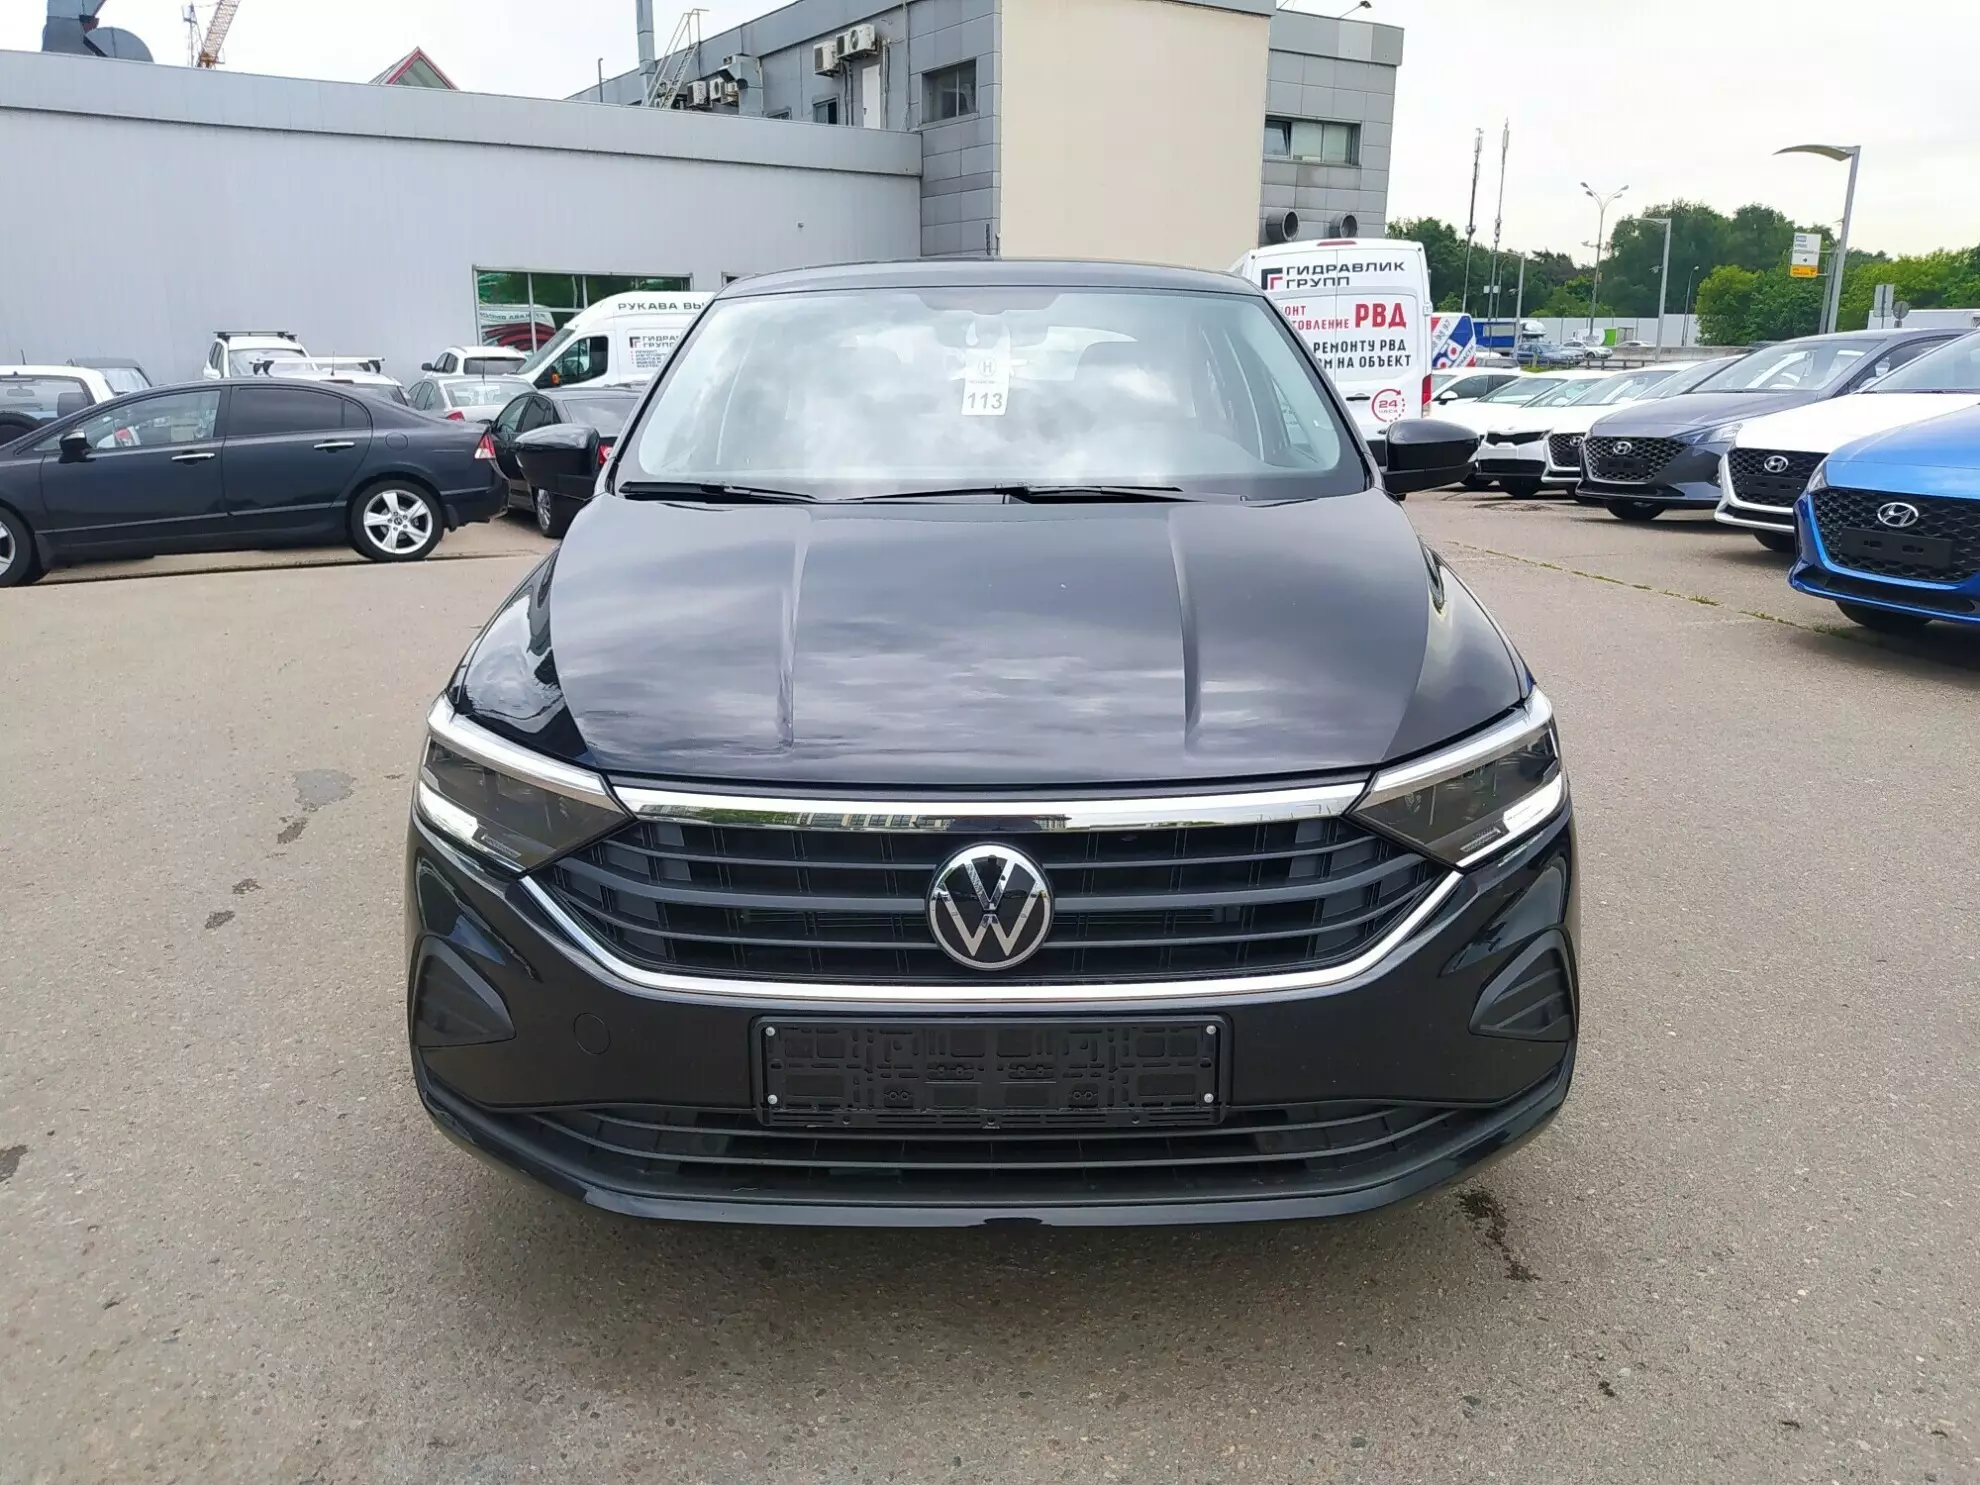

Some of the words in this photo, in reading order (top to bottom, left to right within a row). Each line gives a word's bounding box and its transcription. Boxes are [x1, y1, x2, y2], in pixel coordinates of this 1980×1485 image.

[1287, 262, 1405, 276] ГИДРАВЛИК
[1287, 276, 1350, 289] ГРУПП
[618, 302, 678, 310] РУКАВА
[1355, 303, 1407, 329] РВД
[1313, 340, 1375, 354] РЕМОНТУ
[1380, 339, 1407, 352] РВД
[1337, 357, 1355, 369] НА
[1359, 355, 1411, 368] ОБЪЕКТ
[967, 392, 1003, 409] 113
[1379, 400, 1398, 408] 24
